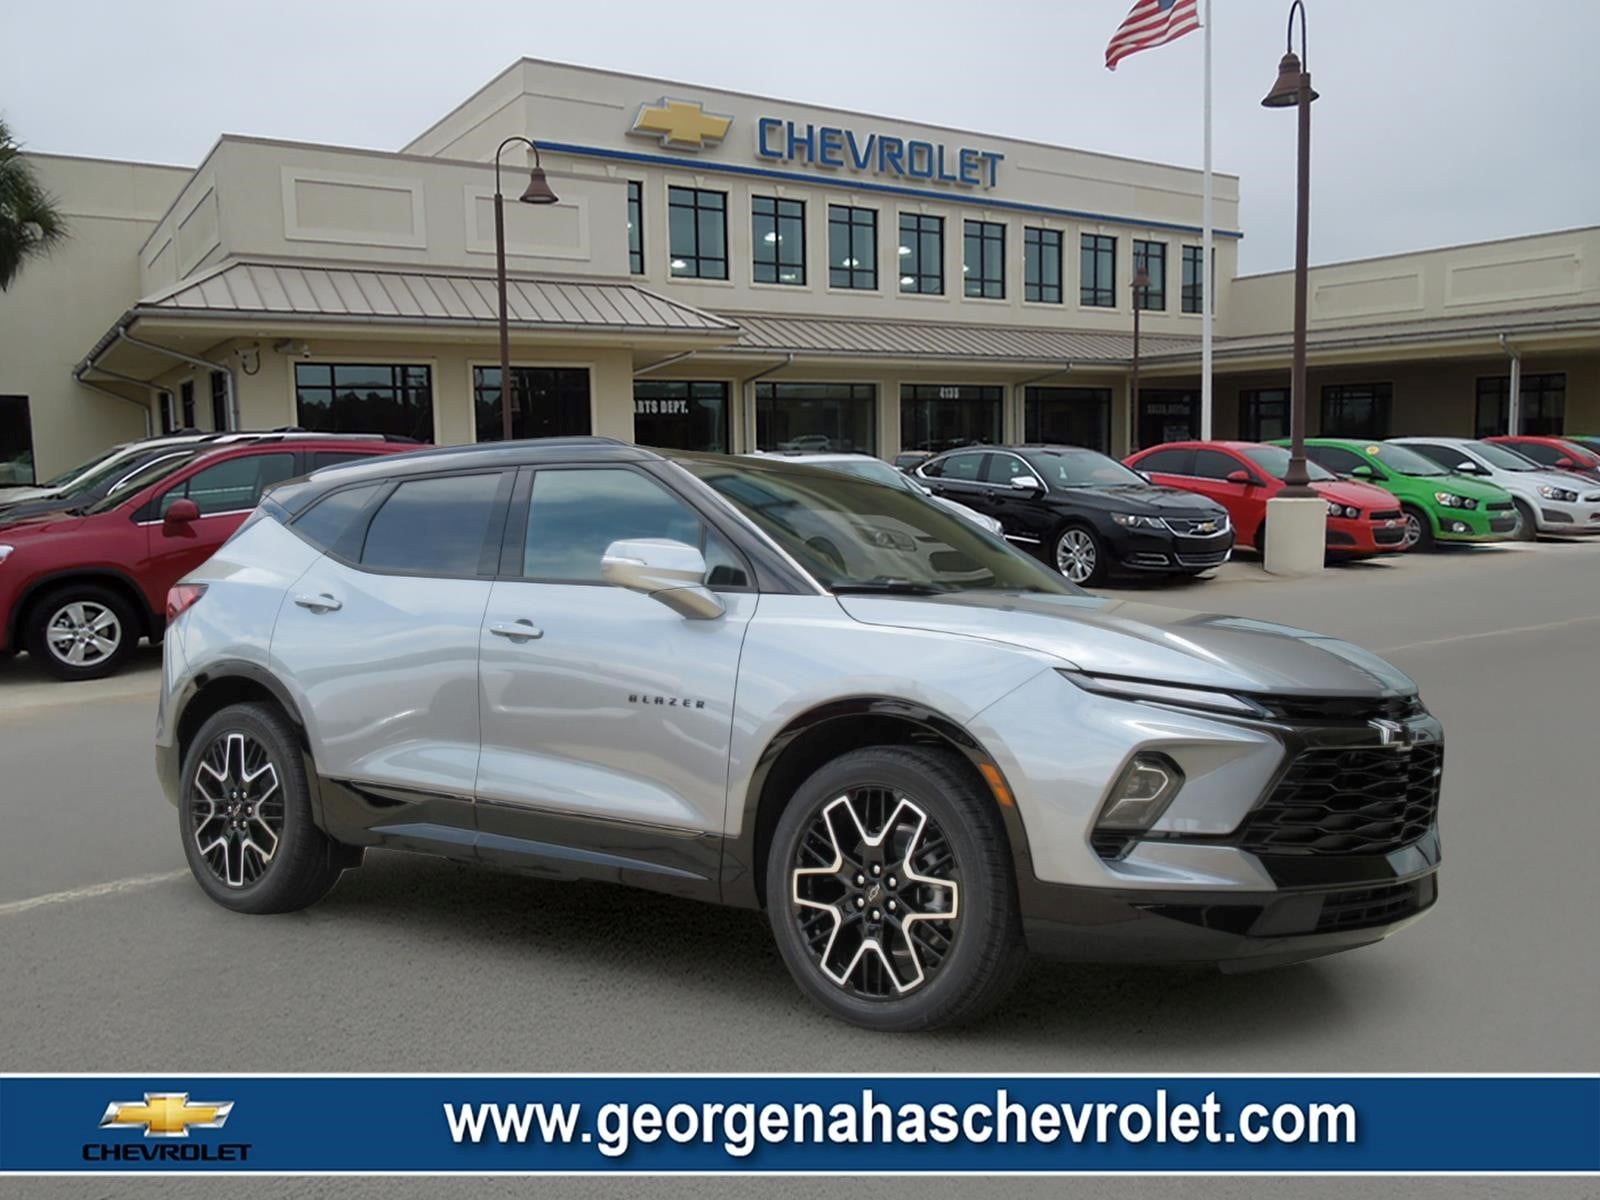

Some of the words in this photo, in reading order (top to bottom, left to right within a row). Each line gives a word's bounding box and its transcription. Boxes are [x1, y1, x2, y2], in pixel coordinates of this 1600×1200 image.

[757, 116, 1005, 188] CHEVROLET
[660, 400, 689, 414] DEPT.
[628, 694, 705, 709] BLAZER
